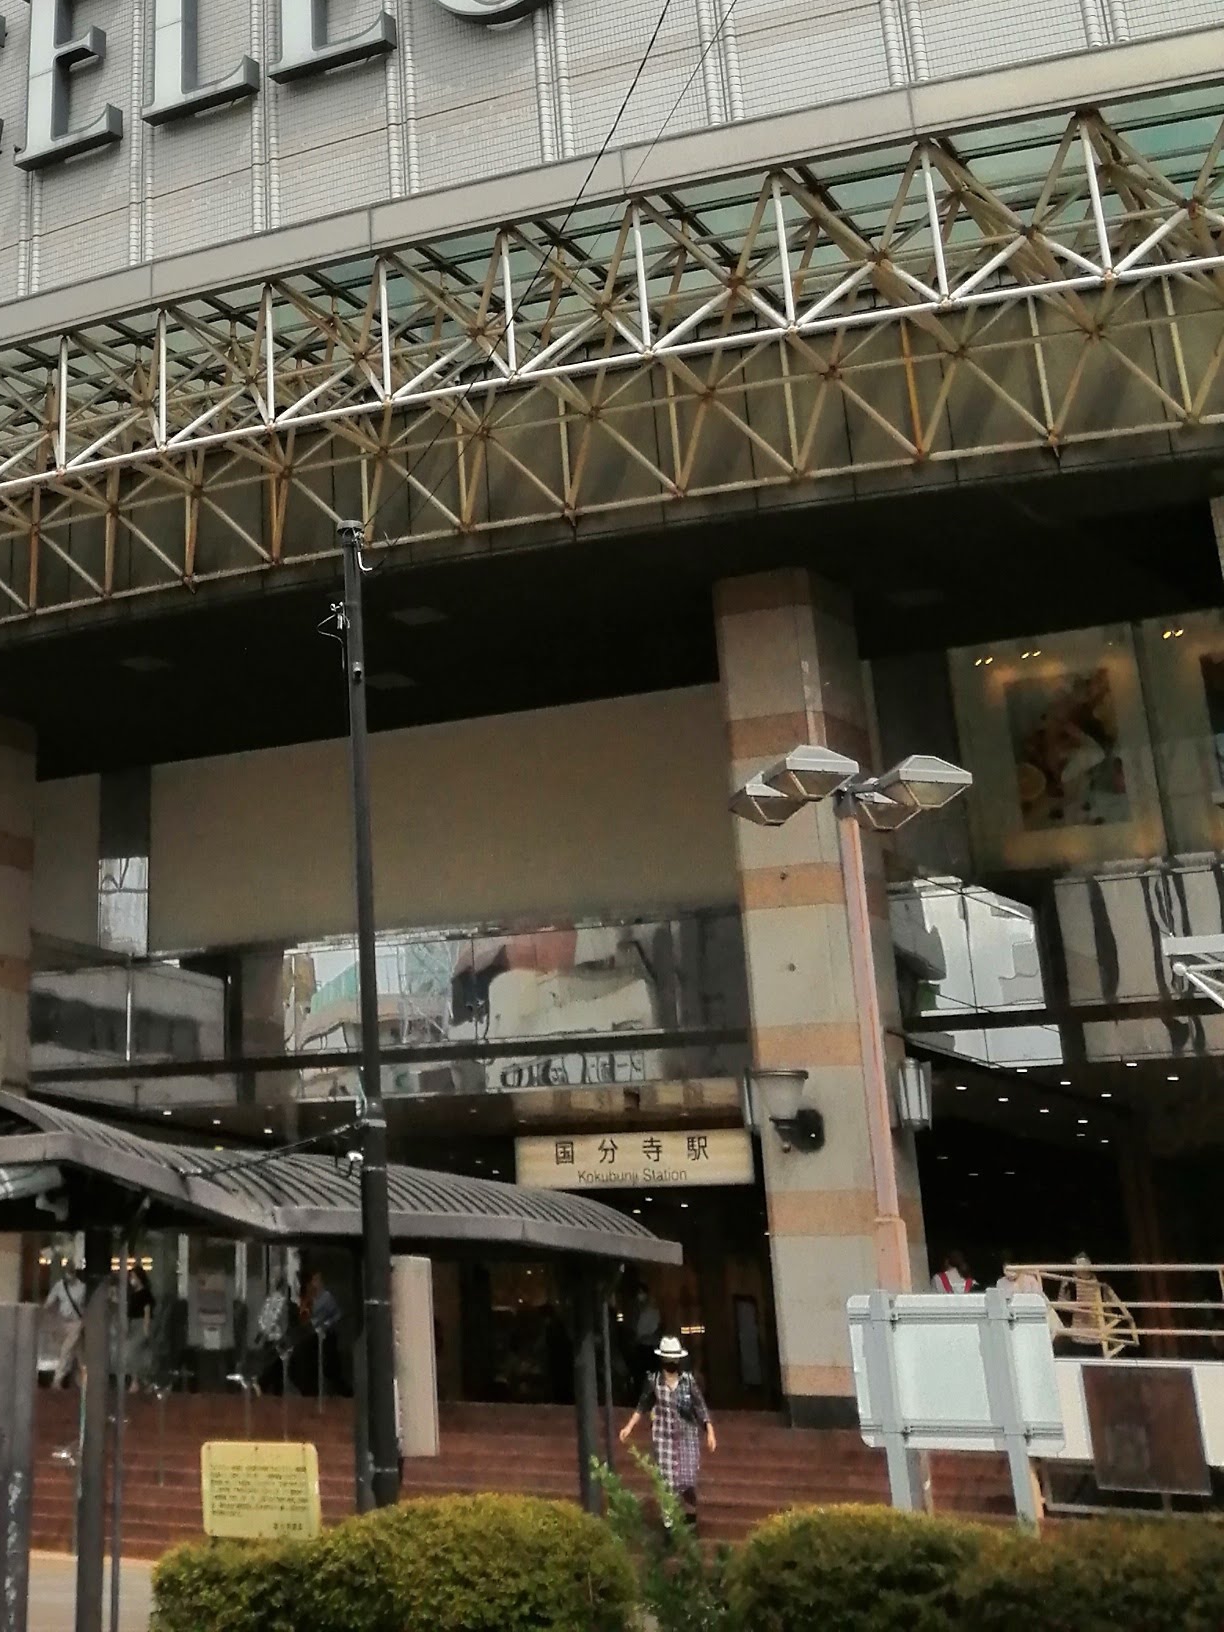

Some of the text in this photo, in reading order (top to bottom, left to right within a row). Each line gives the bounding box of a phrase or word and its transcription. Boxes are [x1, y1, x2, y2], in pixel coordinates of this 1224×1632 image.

[555, 1135, 709, 1165] 国分寺駅
[577, 1167, 688, 1185] Kokubunji Station
